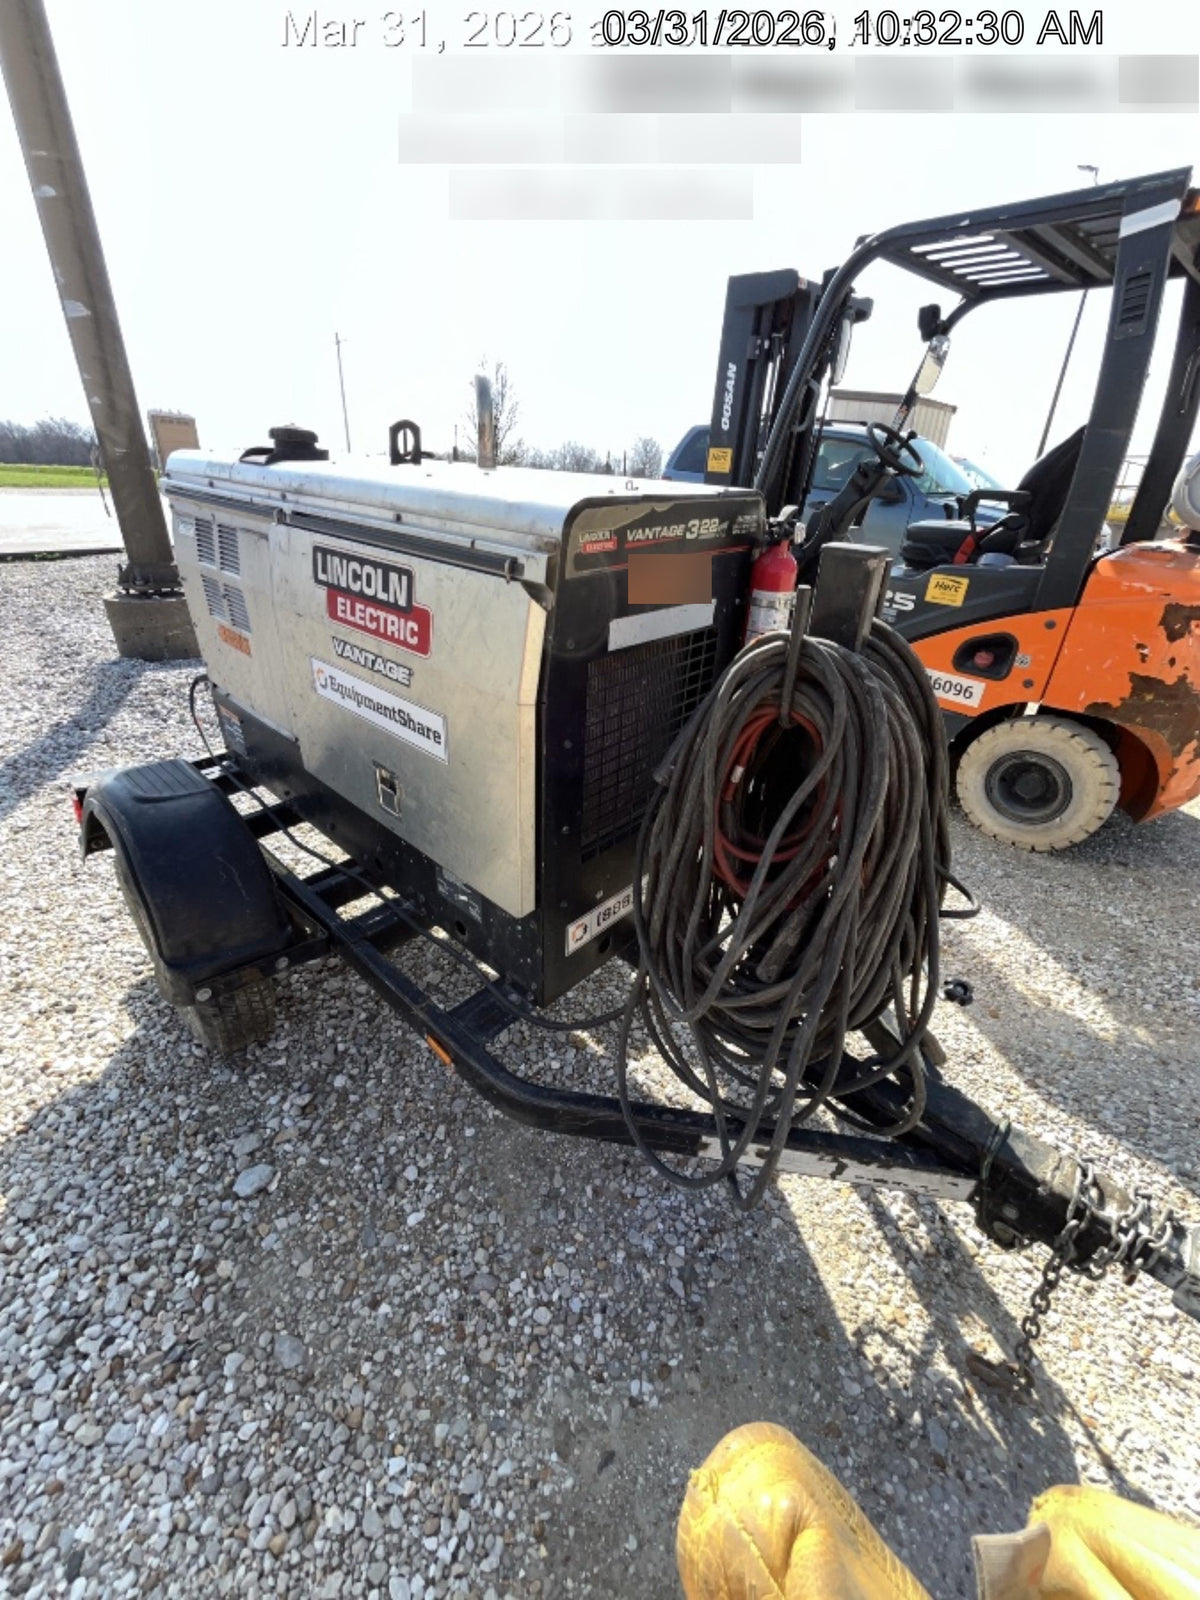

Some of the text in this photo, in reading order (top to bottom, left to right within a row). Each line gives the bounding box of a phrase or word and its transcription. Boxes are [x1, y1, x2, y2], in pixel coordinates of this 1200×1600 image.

[626, 524, 686, 541] VANTAGE
[686, 517, 719, 540] 322
[316, 551, 409, 608] LINCOLN
[337, 596, 419, 645] ELECTRIC
[332, 636, 413, 688] VANTAGE
[929, 675, 974, 699] 6096
[328, 675, 442, 745] EquipmentShare
